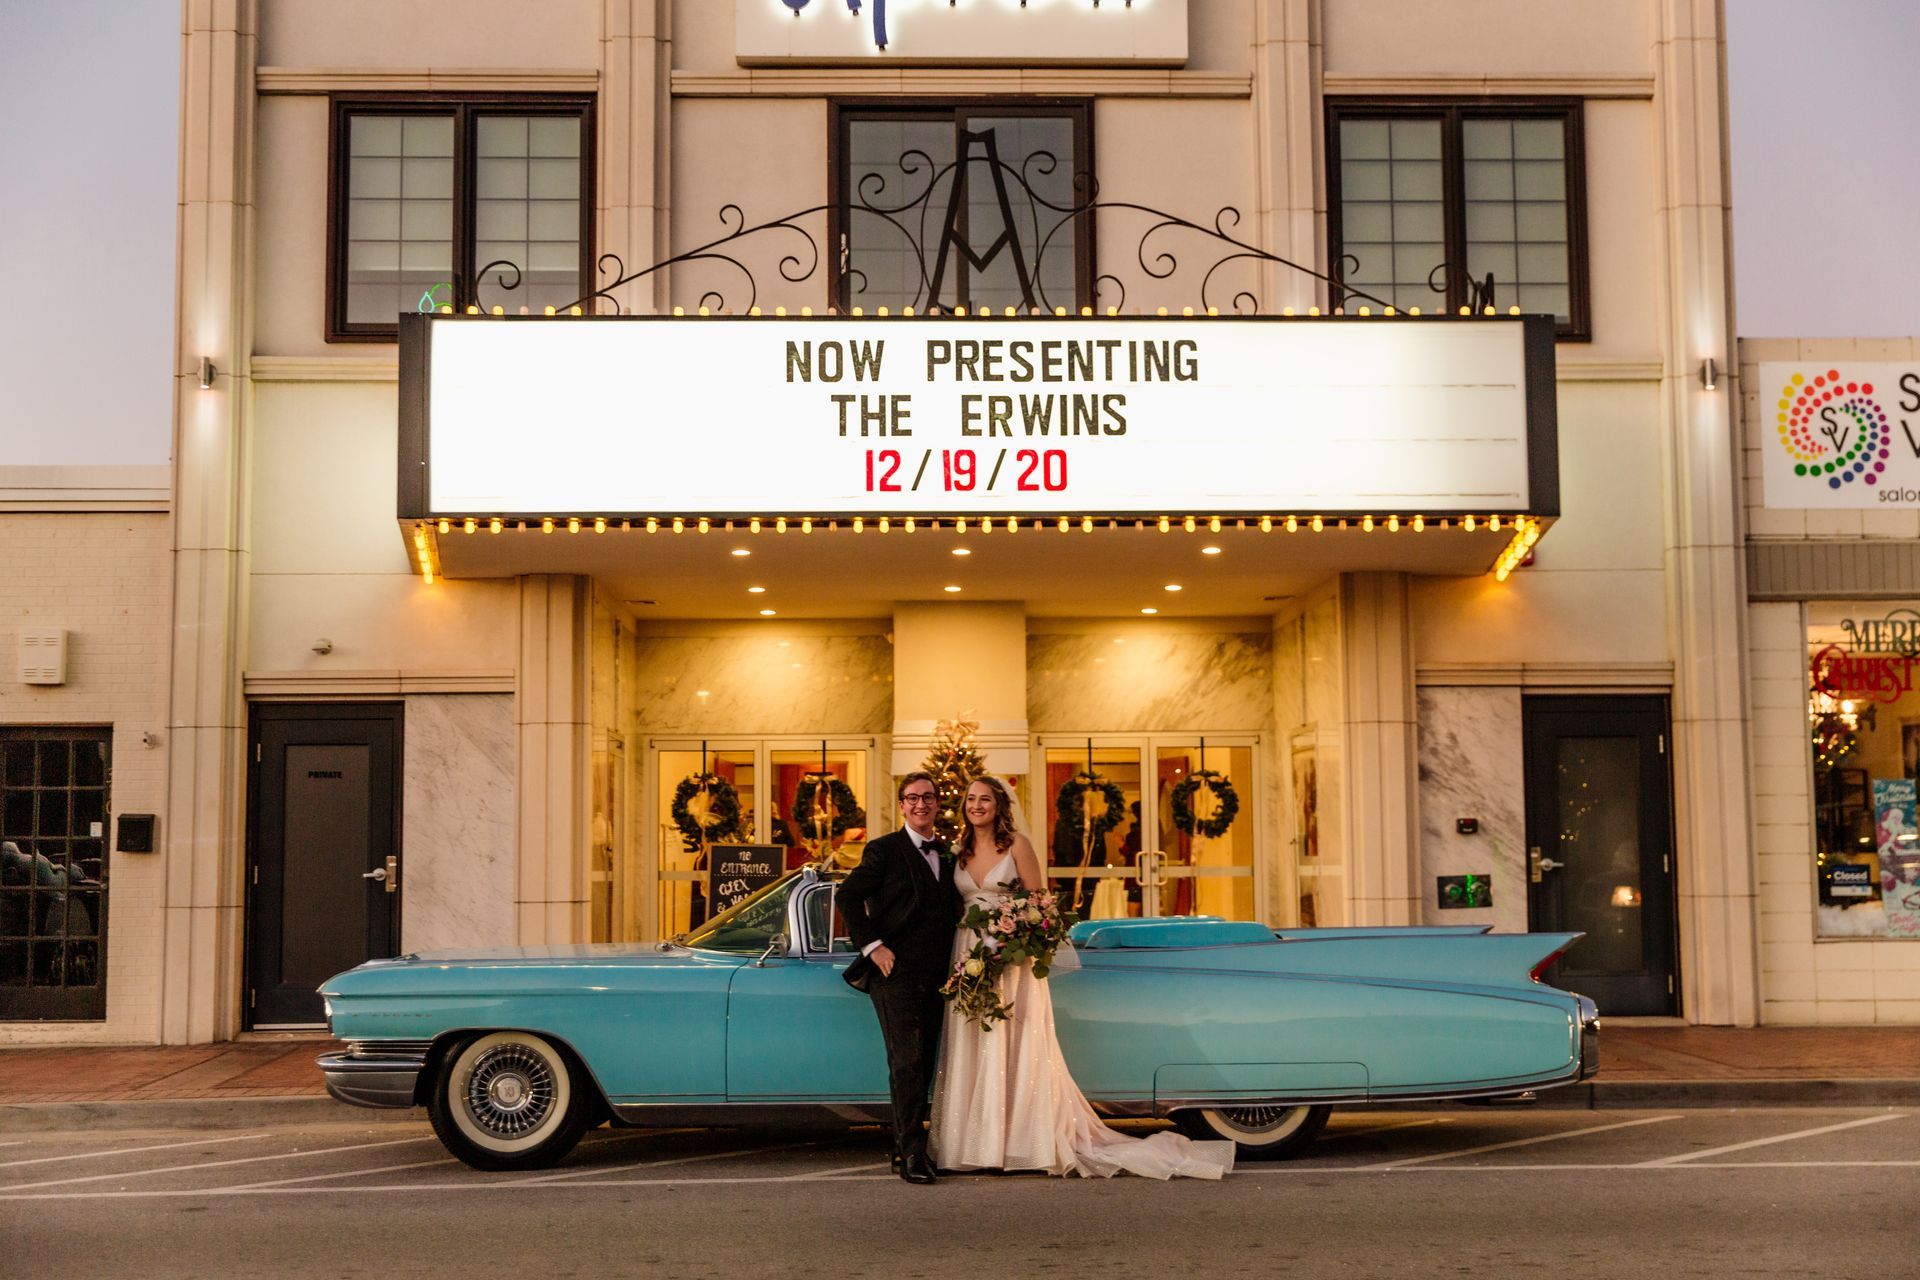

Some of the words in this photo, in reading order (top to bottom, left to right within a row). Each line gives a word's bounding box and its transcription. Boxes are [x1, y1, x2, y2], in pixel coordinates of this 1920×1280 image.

[787, 340, 884, 382] NOW
[927, 340, 1198, 382] PRESENTING
[831, 395, 912, 437] THE
[962, 394, 1126, 437] ERWINS
[866, 449, 1067, 492] 12/19/20
[308, 771, 342, 779] PRIVATE
[1834, 870, 1868, 881] Closed
